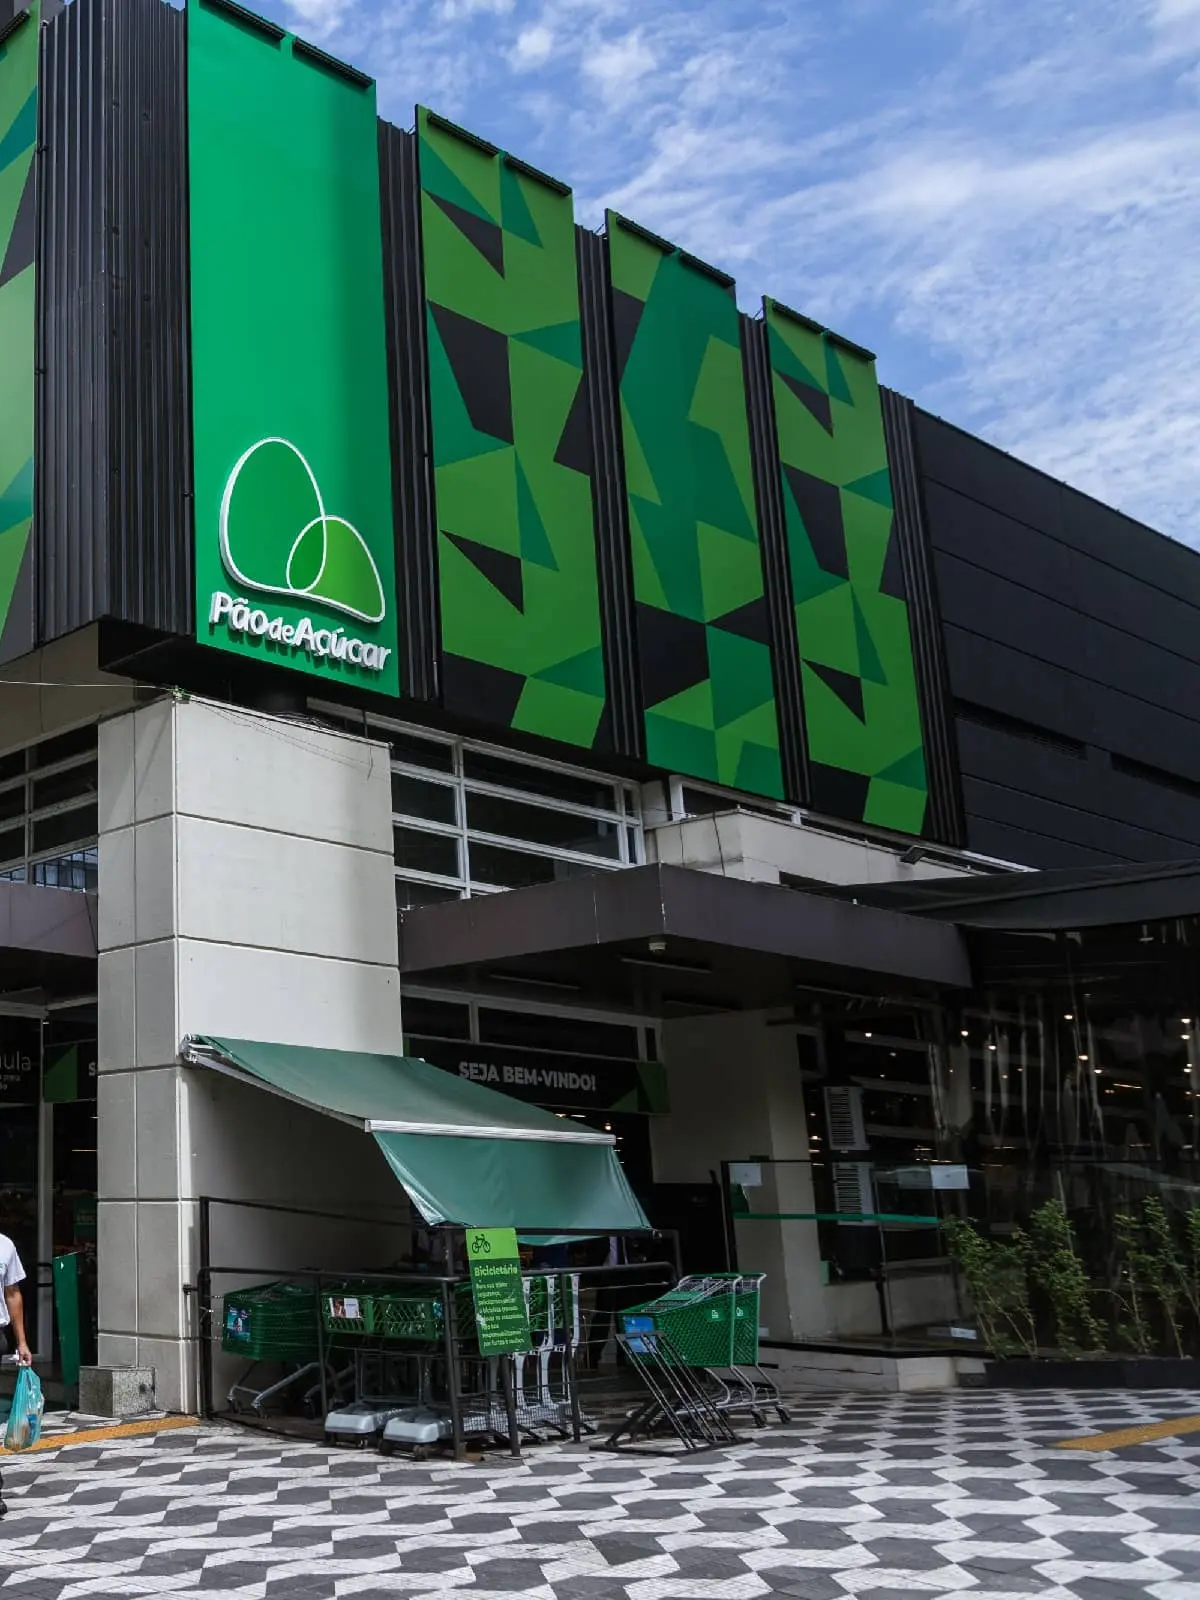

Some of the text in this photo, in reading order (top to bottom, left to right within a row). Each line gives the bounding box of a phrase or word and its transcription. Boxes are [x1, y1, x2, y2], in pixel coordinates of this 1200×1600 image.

[458, 1061, 596, 1091] SEJA BEM-VINDO!
[474, 1264, 518, 1277] Bicicletário
